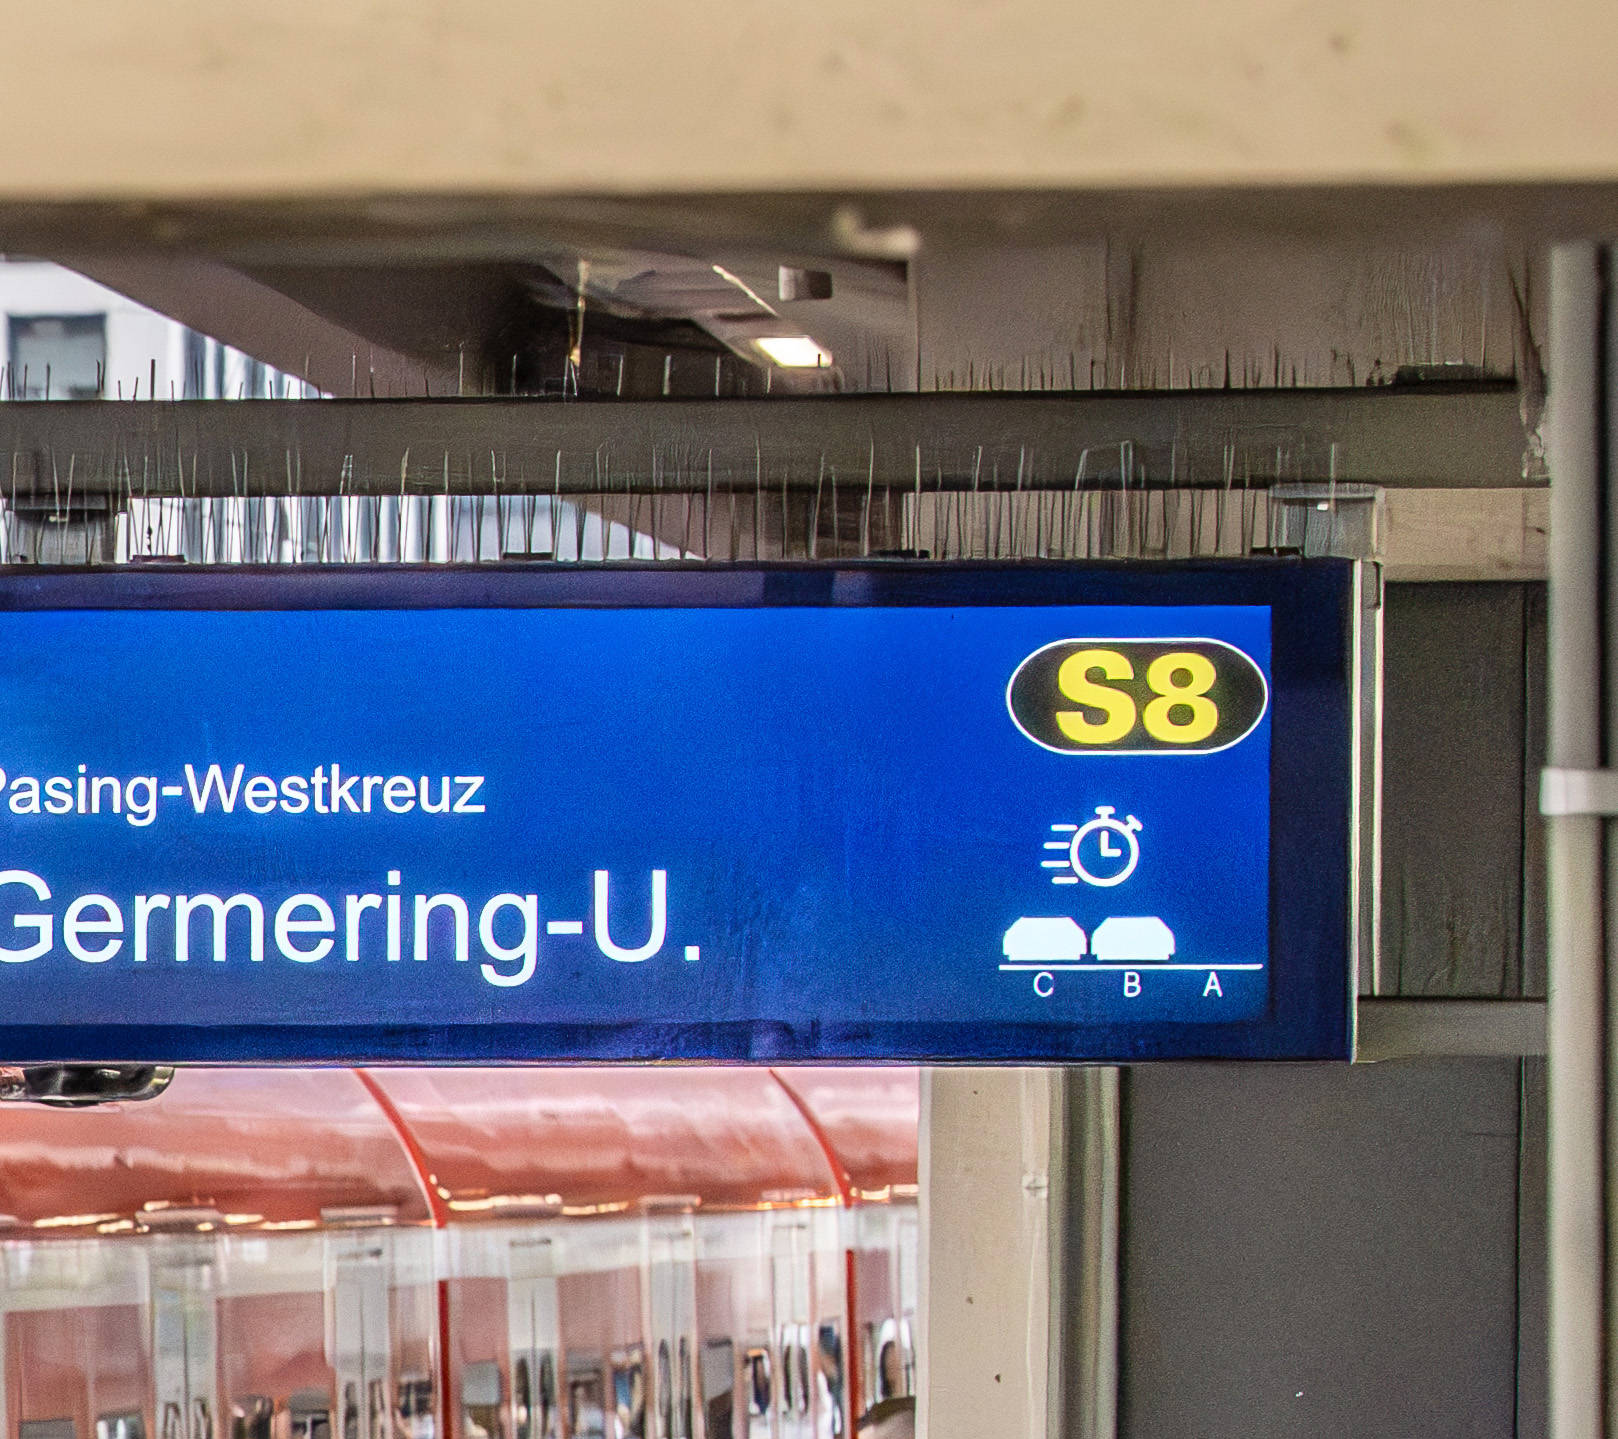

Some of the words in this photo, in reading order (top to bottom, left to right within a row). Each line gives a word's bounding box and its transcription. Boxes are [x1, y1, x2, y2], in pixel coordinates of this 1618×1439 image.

[1055, 648, 1219, 744] S8
[1032, 972, 1055, 998] C
[1123, 972, 1142, 998] B
[1202, 971, 1224, 998] A
